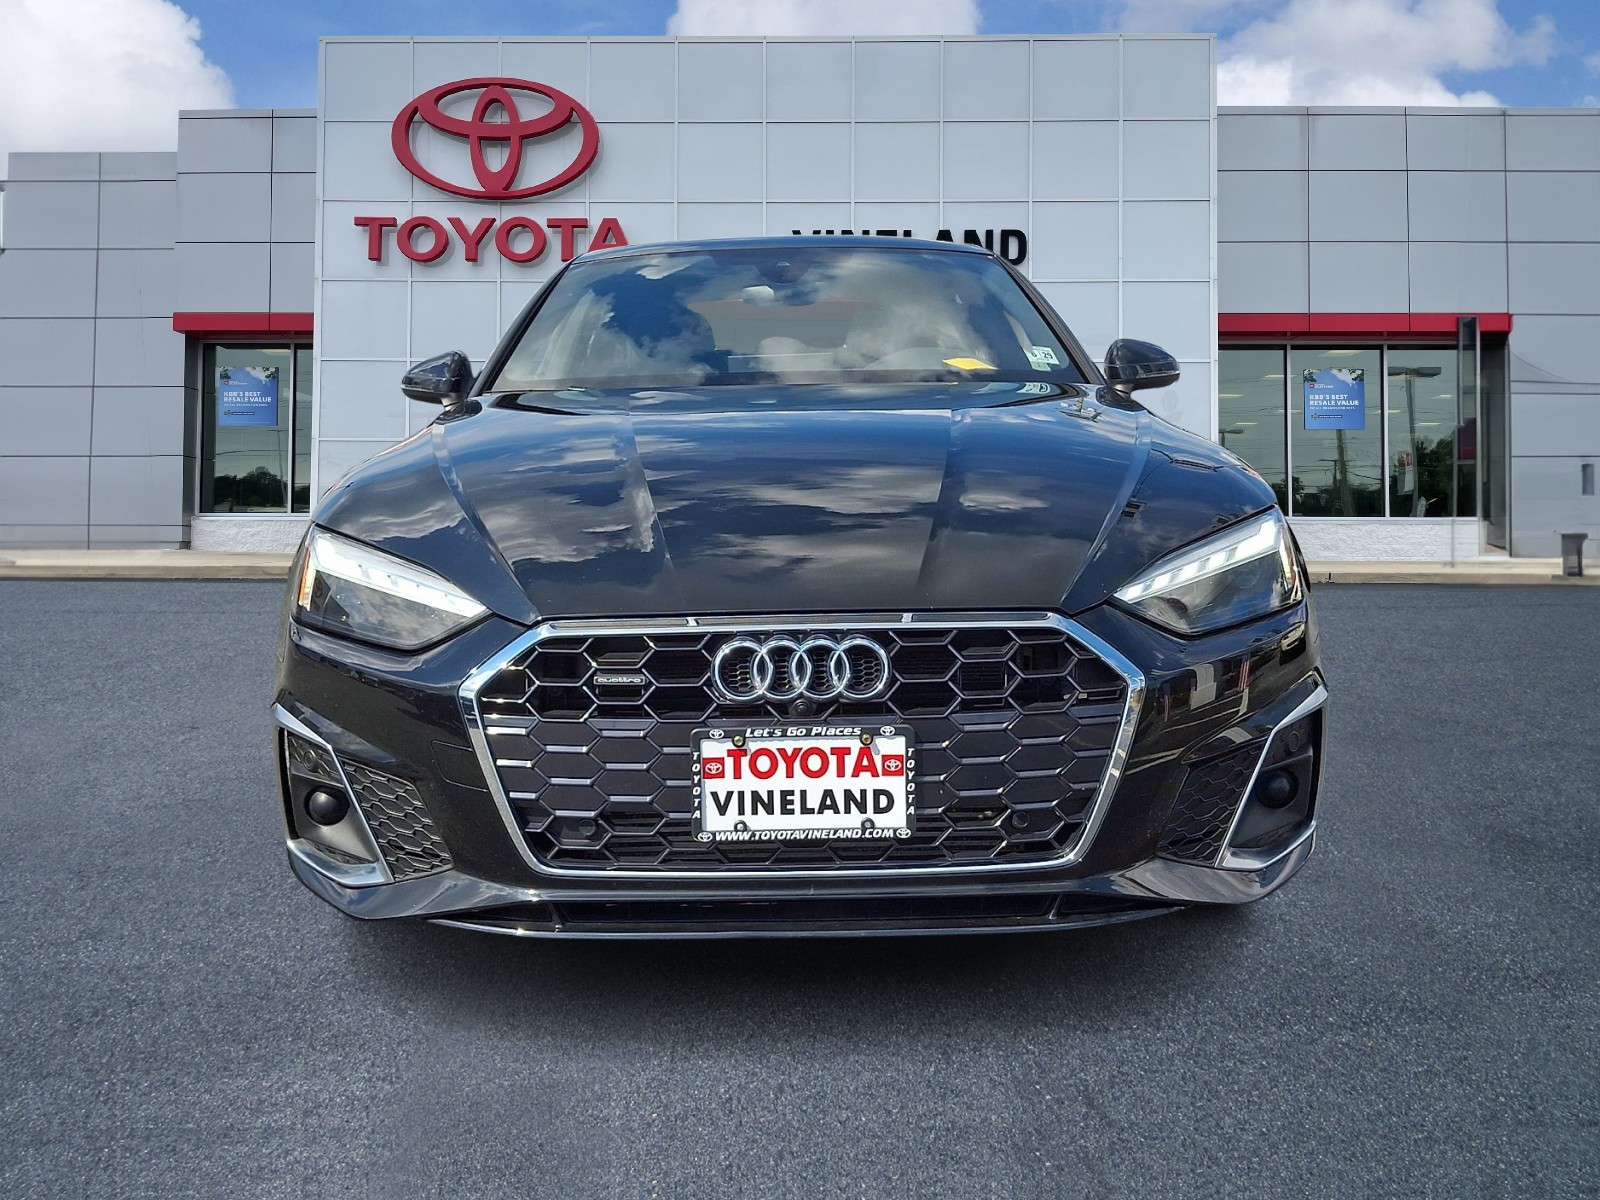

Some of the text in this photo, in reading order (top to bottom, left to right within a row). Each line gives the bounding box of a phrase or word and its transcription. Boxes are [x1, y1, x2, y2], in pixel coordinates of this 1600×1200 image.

[354, 216, 630, 263] TOYOTA
[745, 726, 862, 737] Let's Go Places
[726, 746, 880, 780] TOYOTA
[691, 751, 701, 819] TOYOTA
[906, 747, 915, 815] TOYOTA
[710, 788, 895, 816] VINELAND
[715, 828, 894, 841] WWW.TOYOTAVINELAND.COM
